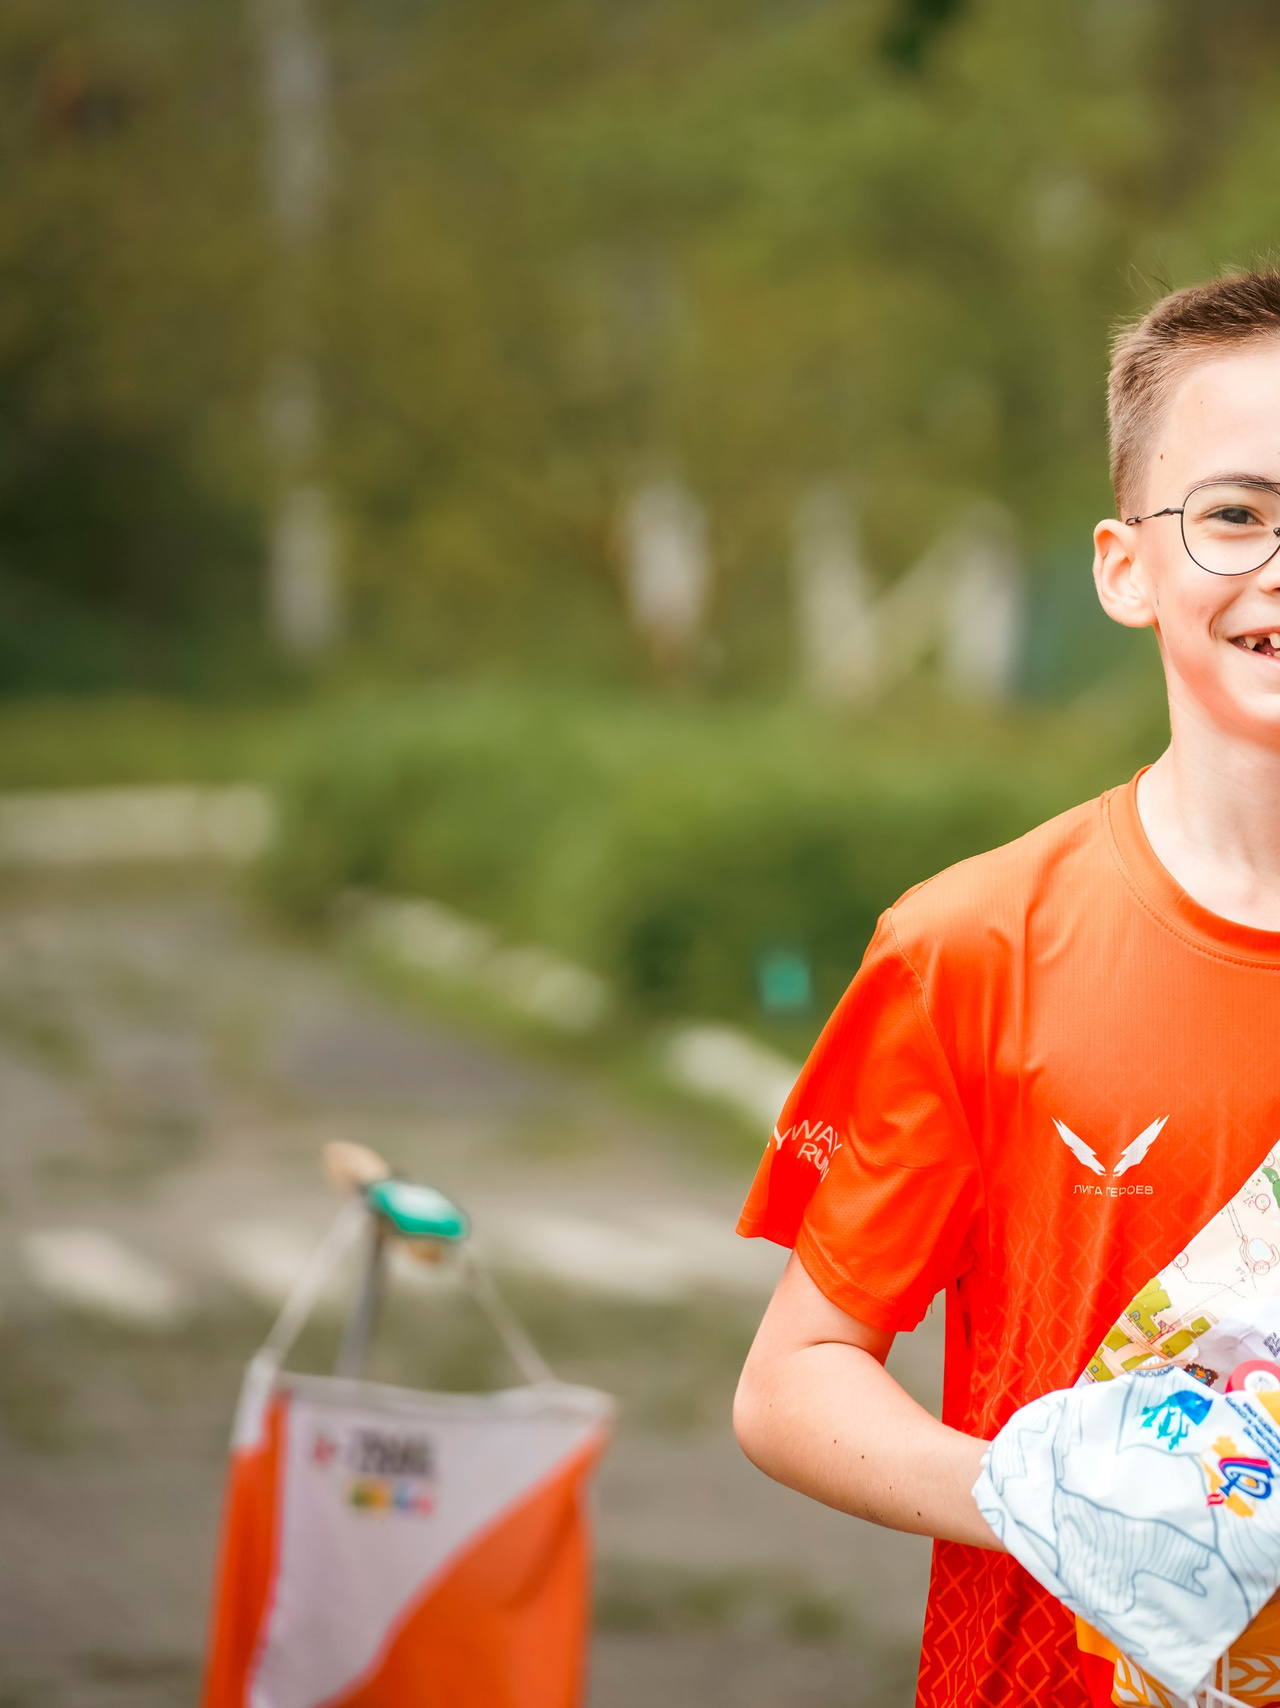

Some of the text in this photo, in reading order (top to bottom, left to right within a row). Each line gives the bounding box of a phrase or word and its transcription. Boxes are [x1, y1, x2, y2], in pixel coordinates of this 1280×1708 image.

[796, 1142, 830, 1183] RUN
[1073, 1184, 1154, 1198] ЛИГА ГЕРОЕВ
